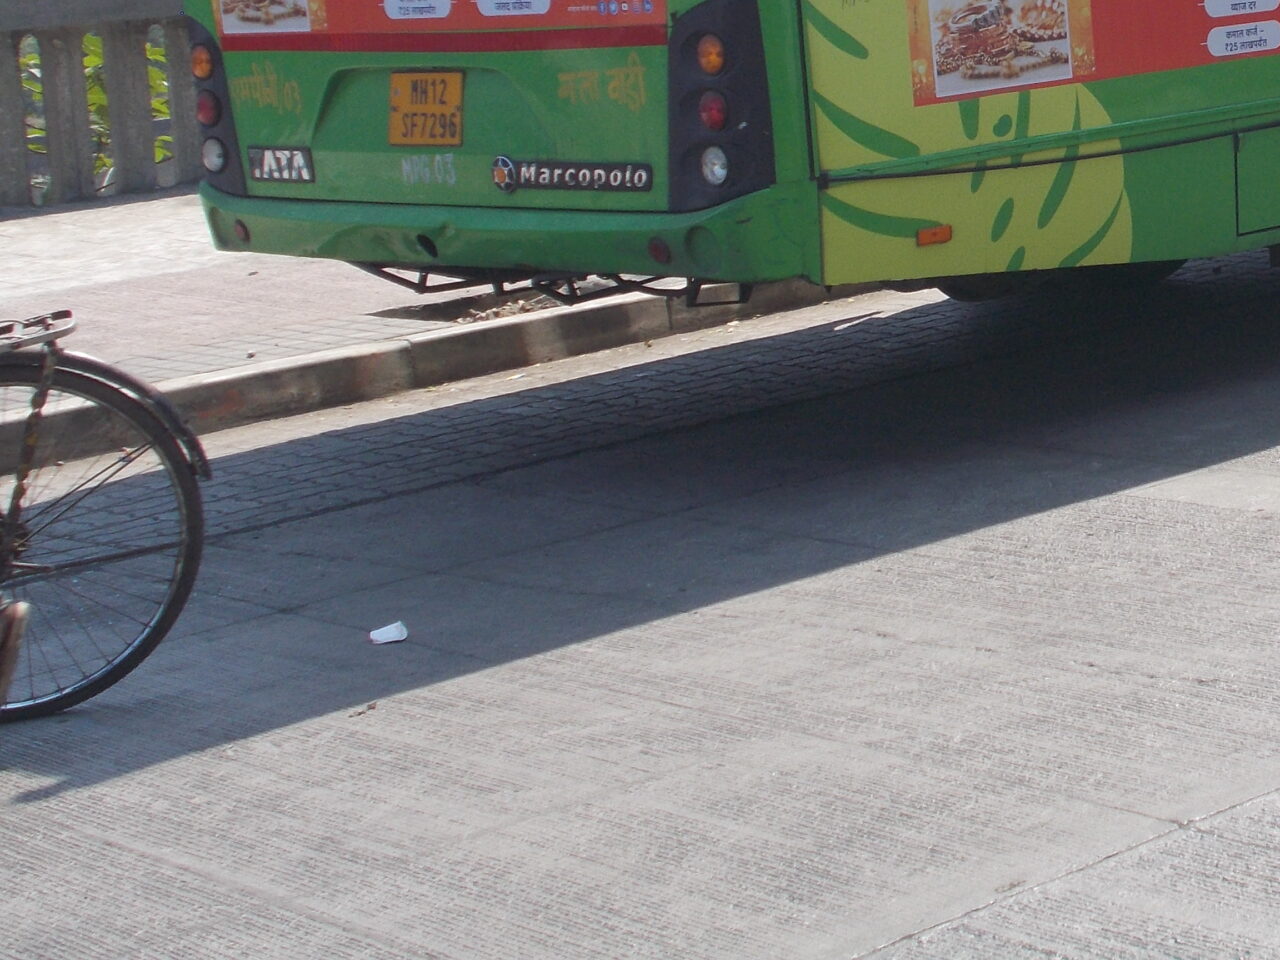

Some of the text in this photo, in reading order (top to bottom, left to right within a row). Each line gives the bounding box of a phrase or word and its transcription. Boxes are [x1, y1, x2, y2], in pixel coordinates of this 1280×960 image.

[410, 78, 448, 105] MH12
[401, 112, 458, 139] SF7296
[520, 162, 648, 189] Marcopolo
